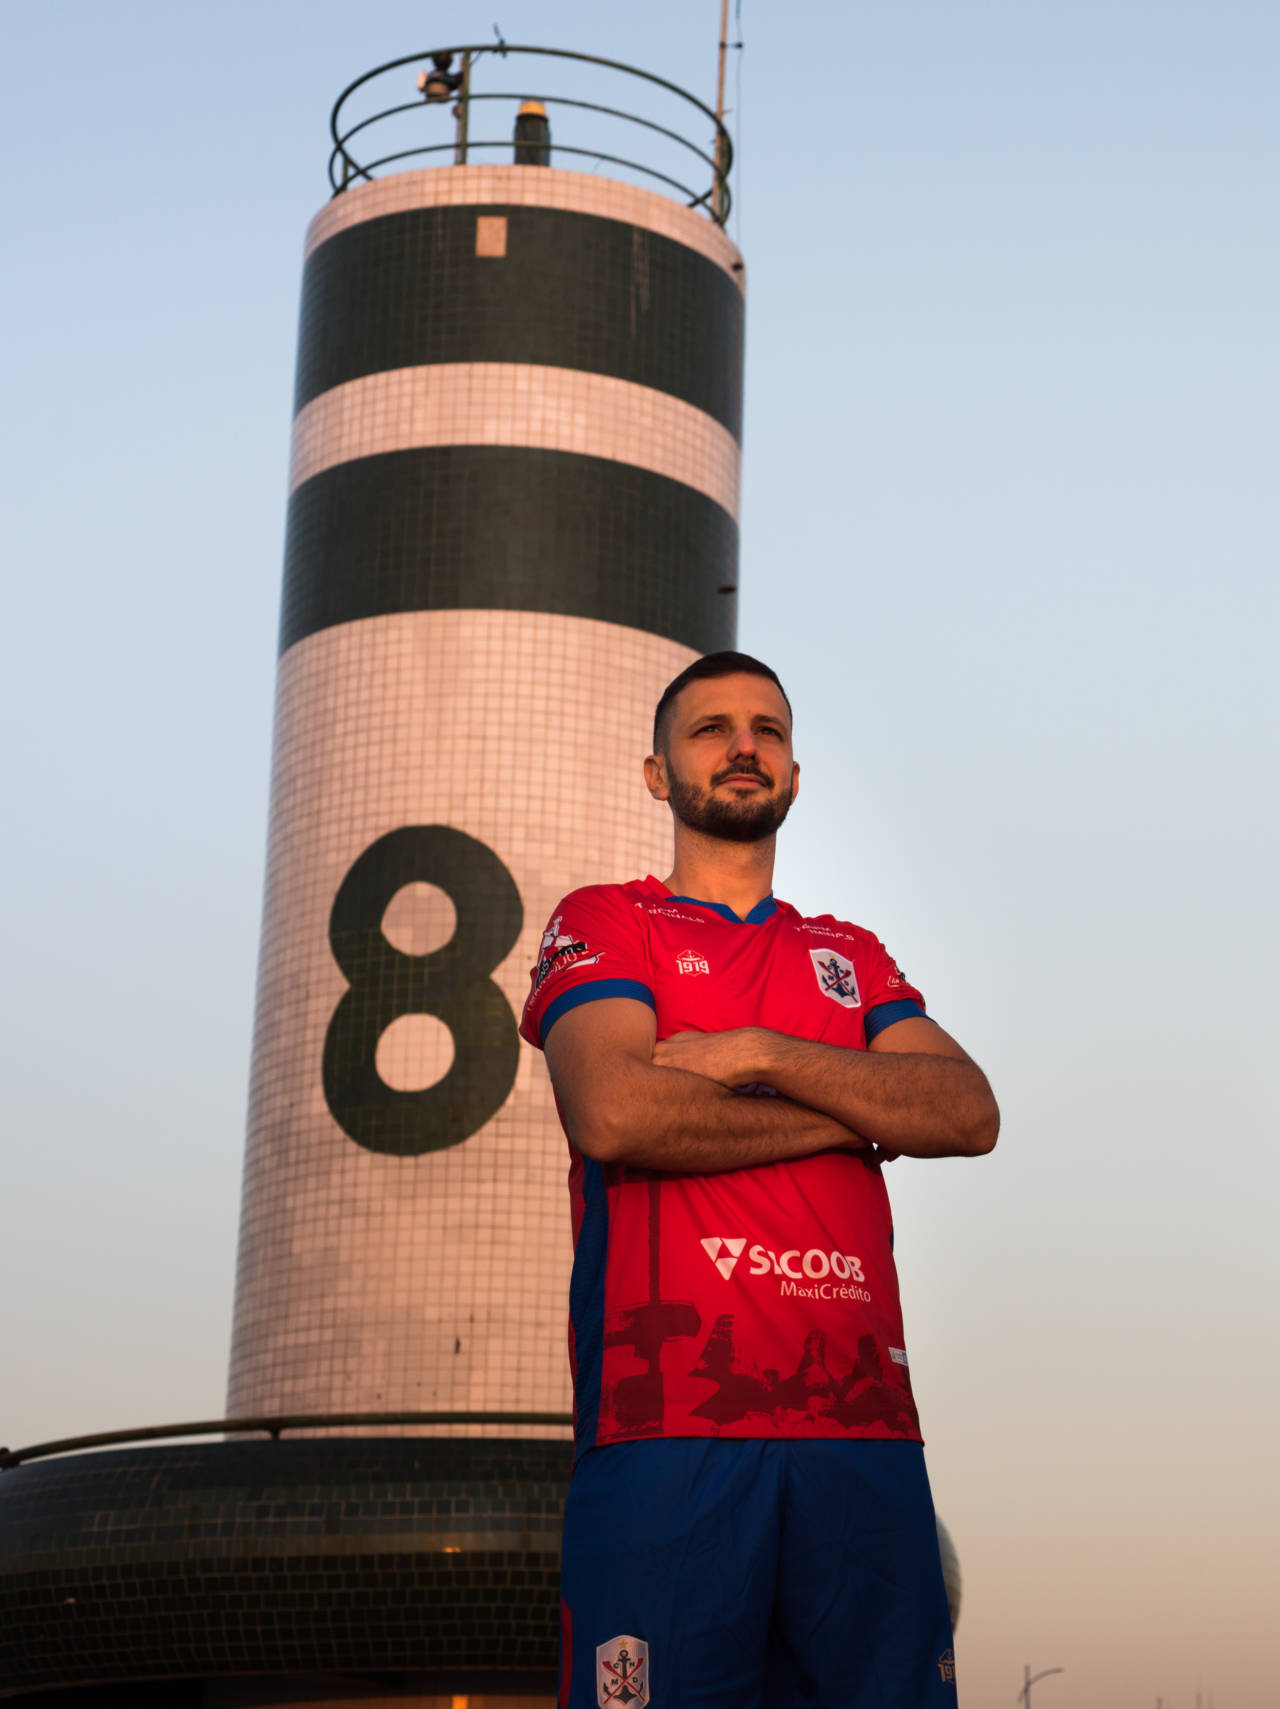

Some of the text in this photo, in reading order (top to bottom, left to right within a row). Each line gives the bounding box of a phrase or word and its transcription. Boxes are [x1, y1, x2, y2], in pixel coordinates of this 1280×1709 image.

[676, 960, 710, 975] 1919
[322, 824, 524, 1157] 8
[749, 1244, 865, 1283] SICOOB
[780, 1280, 872, 1303] MaxiCrédito
